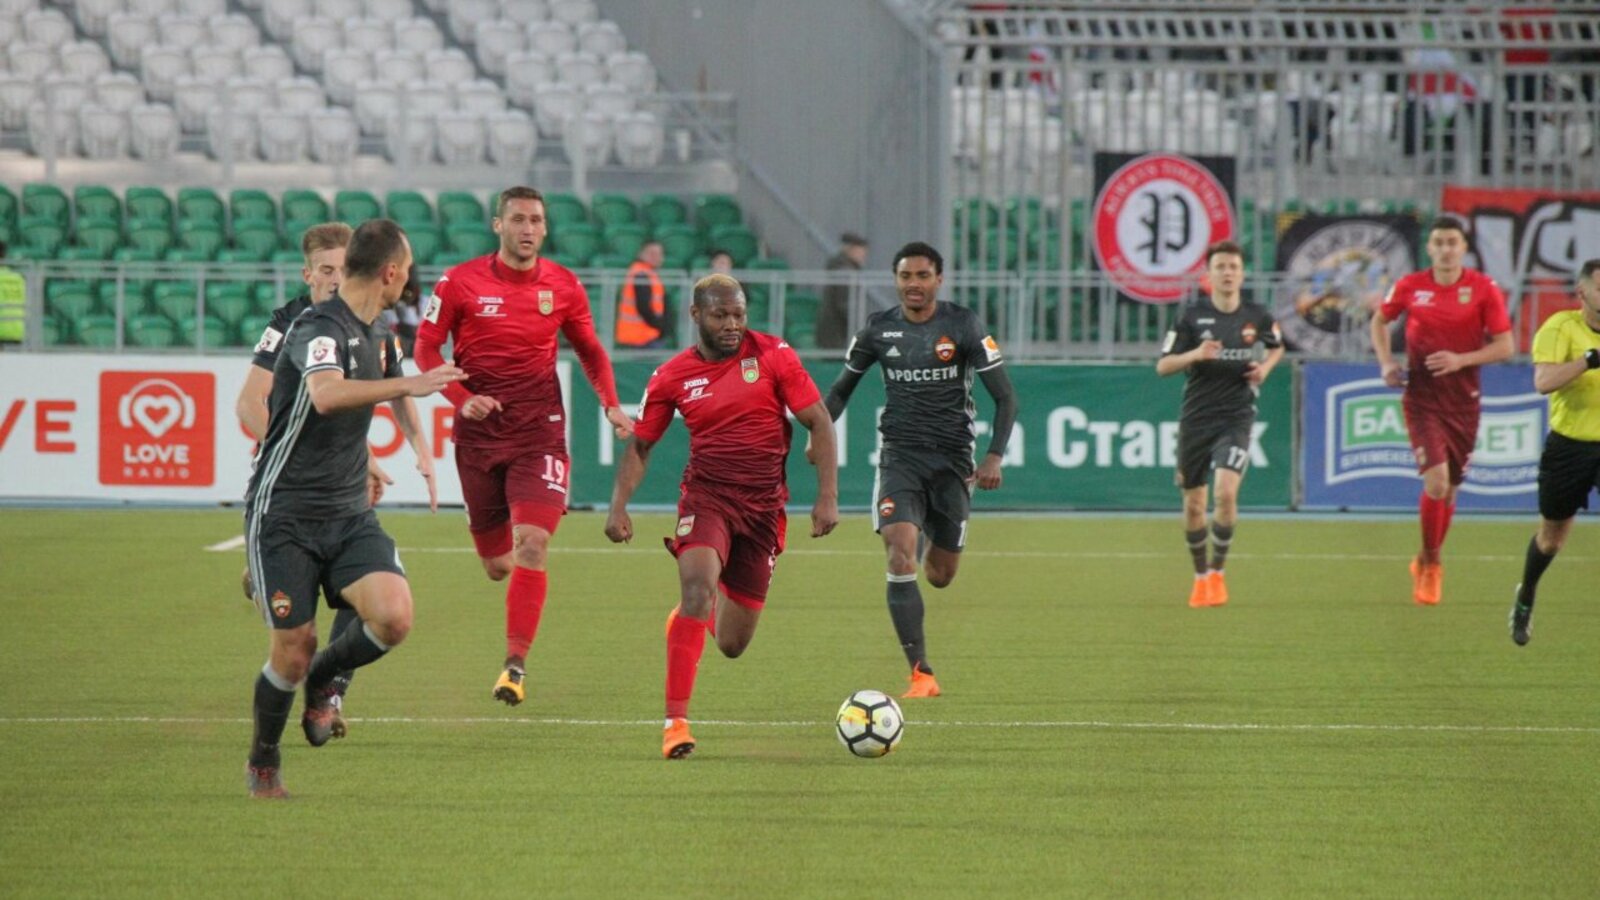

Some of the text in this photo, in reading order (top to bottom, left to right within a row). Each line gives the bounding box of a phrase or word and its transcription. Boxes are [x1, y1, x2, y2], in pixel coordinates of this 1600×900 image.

[896, 365, 958, 382] РОССЕТИ
[1047, 406, 1268, 468] Ставк
[123, 444, 190, 464] LOVE
[1227, 446, 1247, 469] 17
[123, 467, 190, 479] RADIO
[541, 454, 565, 484] 19
